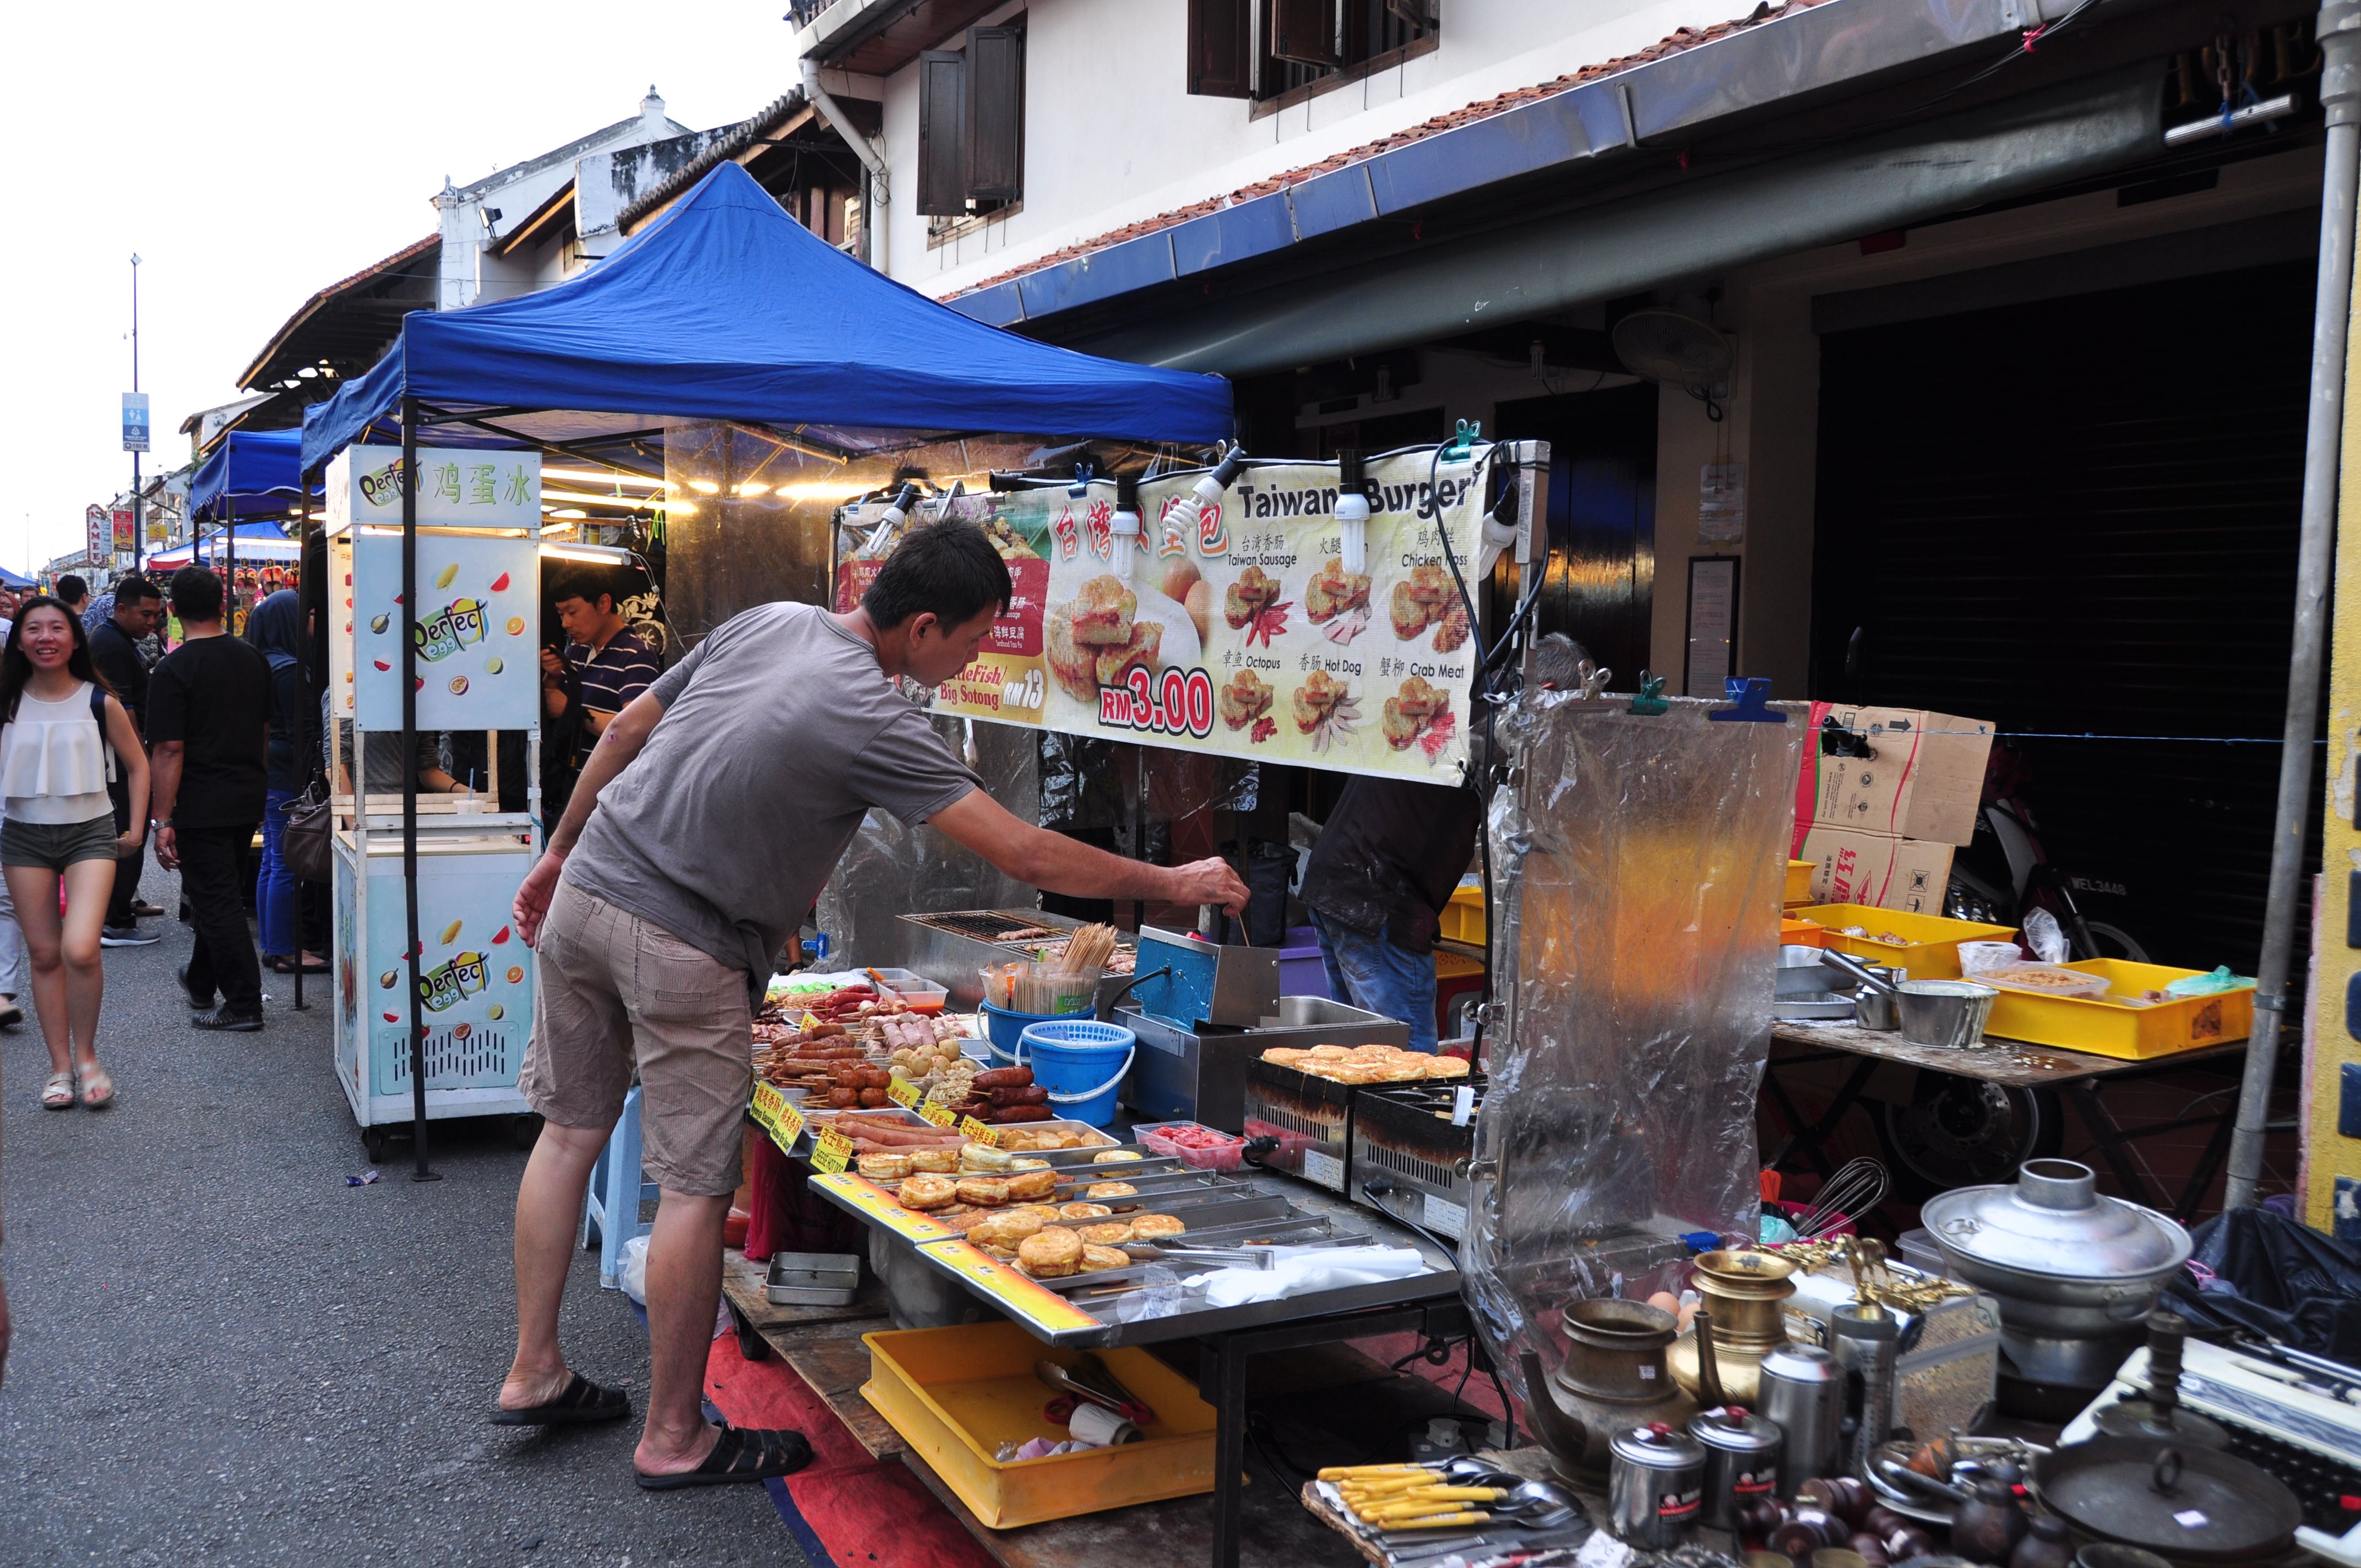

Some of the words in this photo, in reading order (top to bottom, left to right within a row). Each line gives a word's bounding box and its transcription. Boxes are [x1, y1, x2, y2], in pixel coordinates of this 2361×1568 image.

[433, 462, 531, 506] 鸡蛋冰
[1238, 483, 1336, 518] Taiwan
[1363, 477, 1477, 519] Burger
[1242, 534, 1285, 552] 台湾香肠
[1228, 554, 1256, 567] Taiwan
[1259, 554, 1297, 568] Sausage
[1402, 553, 1442, 567] Chicken
[426, 637, 456, 658] egg
[1223, 649, 1243, 668] 章鱼
[1246, 656, 1281, 671] Octopus
[1299, 653, 1321, 672] 香肠
[1325, 659, 1340, 672] Hot
[1342, 660, 1362, 676] Dog
[1380, 656, 1404, 678] 蟹柳
[1410, 662, 1435, 678] Crab
[1438, 663, 1465, 679] Meat
[940, 682, 958, 705] Big
[960, 684, 999, 711] Sotong
[1101, 667, 1212, 734] RM3.00
[420, 952, 489, 1011] Perfect
[432, 988, 459, 1008] egg
[813, 1147, 829, 1167] CHEESE
[826, 1157, 836, 1173] HOT
